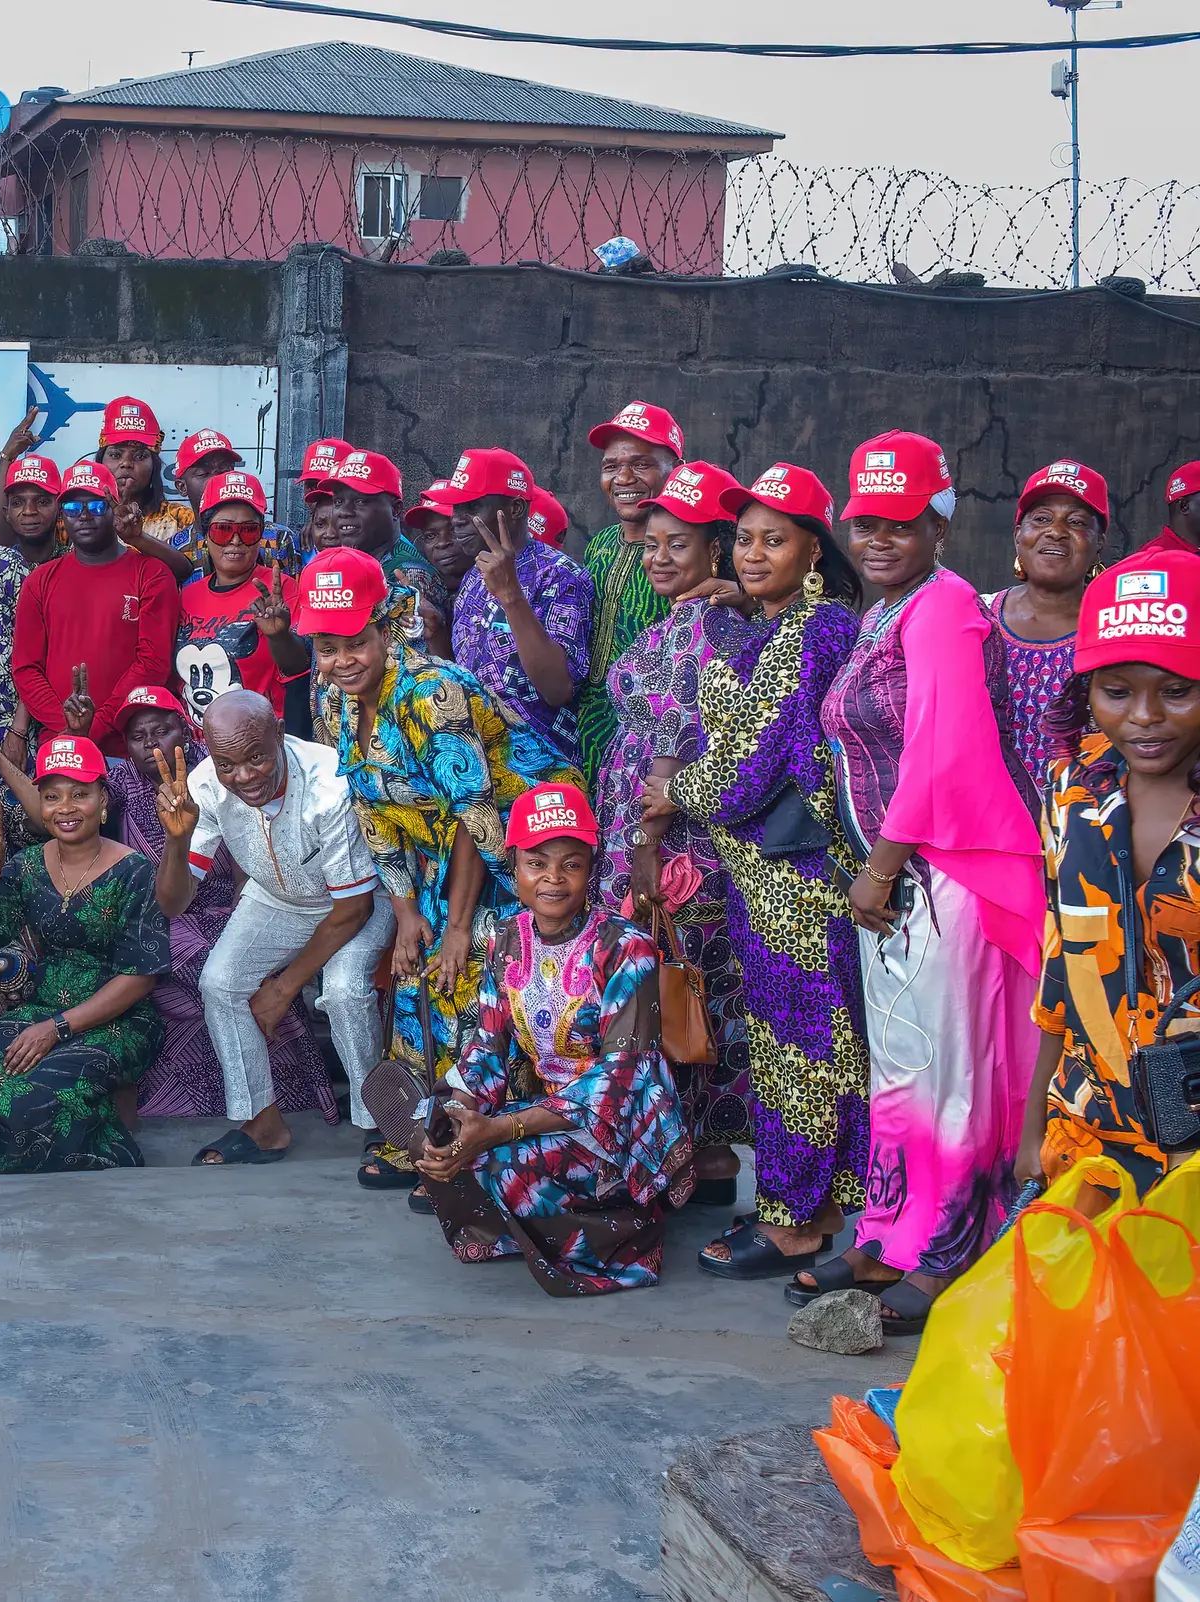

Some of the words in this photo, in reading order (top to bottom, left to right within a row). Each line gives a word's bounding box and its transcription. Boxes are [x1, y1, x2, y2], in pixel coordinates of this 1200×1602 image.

[115, 417, 146, 428] FUNSO
[14, 468, 48, 480] FUNSO
[857, 471, 907, 486] FUNSO
[220, 484, 254, 497] FUNSO
[308, 589, 354, 602] FUNSO
[313, 600, 353, 610] GOVERNOR
[1098, 601, 1188, 630] FUNSO
[1105, 623, 1186, 640] GOVERNOR
[45, 752, 84, 768] FUNSO
[527, 808, 577, 828] FUNSO
[534, 820, 578, 832] GOVERNOR
